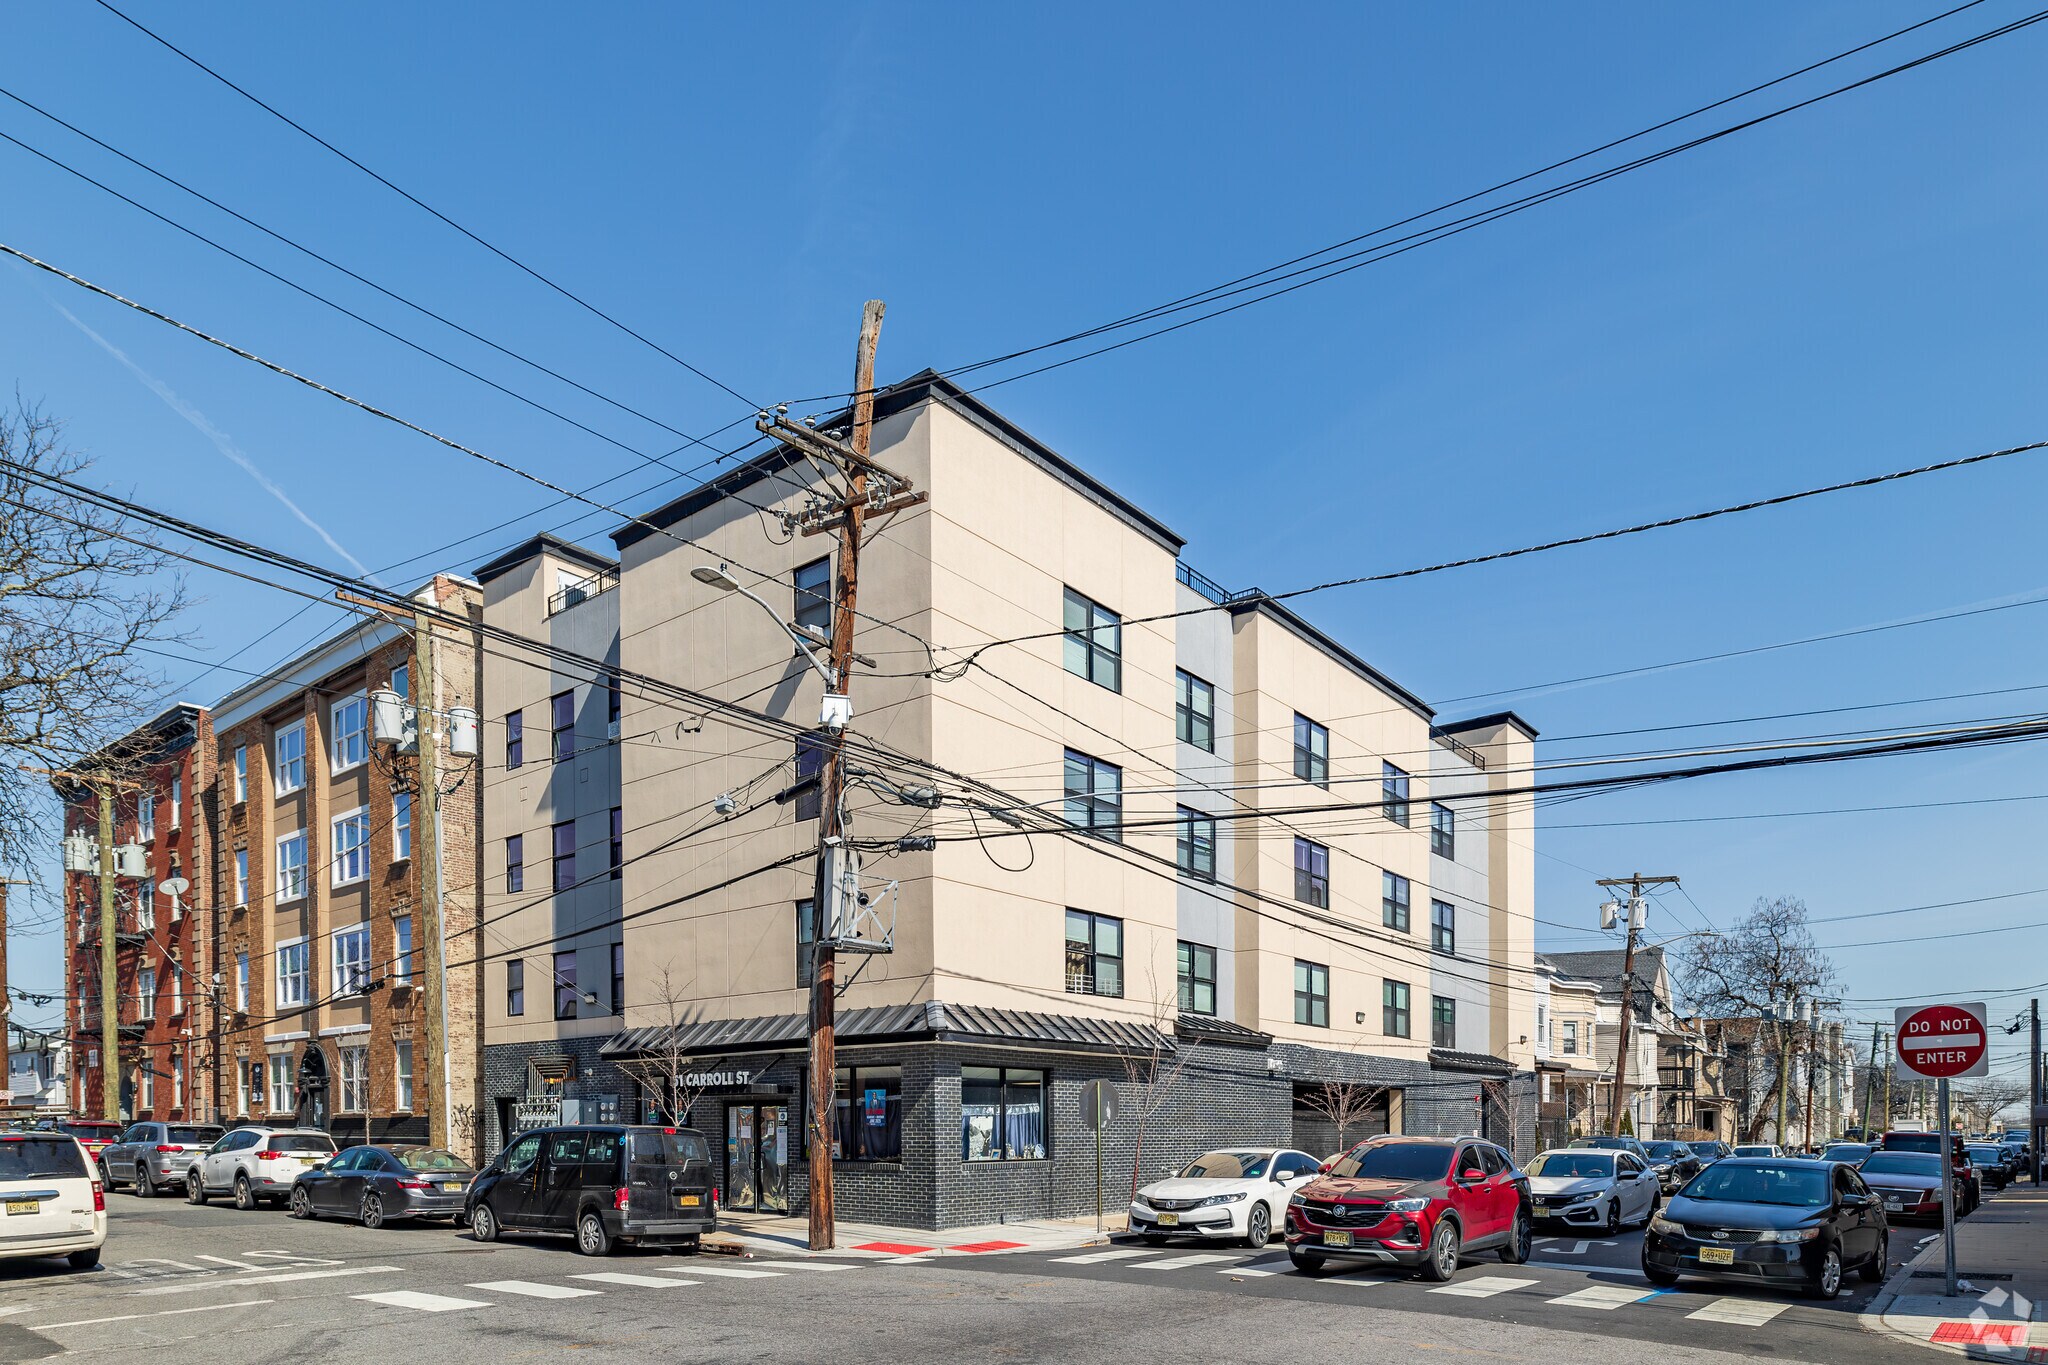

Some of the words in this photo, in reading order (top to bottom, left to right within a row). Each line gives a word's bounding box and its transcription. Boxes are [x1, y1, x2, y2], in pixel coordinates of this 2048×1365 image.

[1909, 1021, 1930, 1033] DO
[1940, 1018, 1972, 1032] NOT
[1916, 1051, 1967, 1064] ENTER
[686, 1072, 734, 1087] CARROLL
